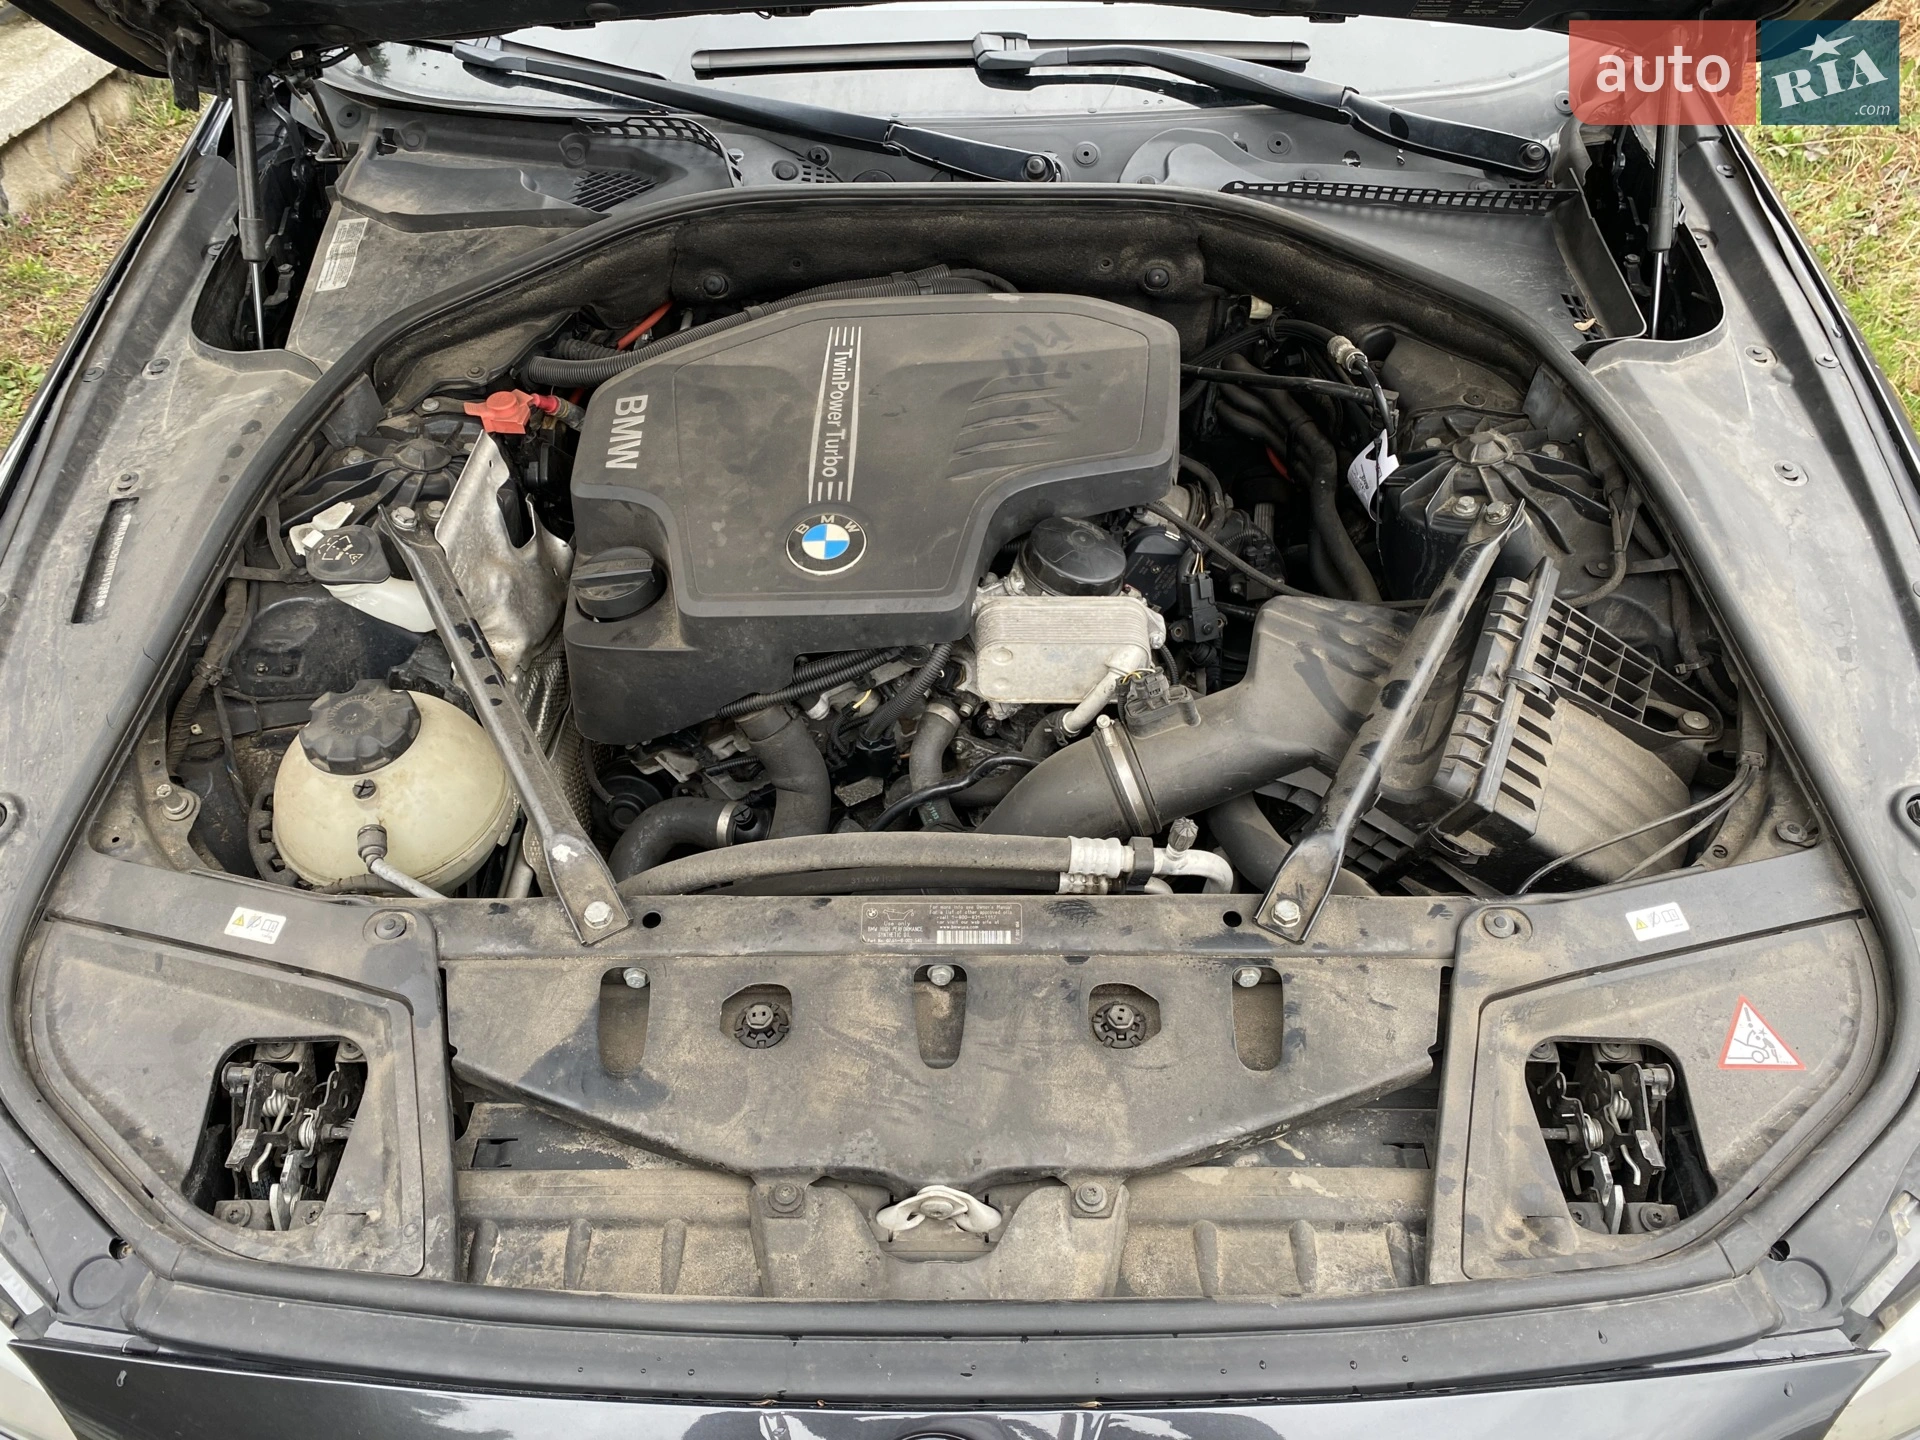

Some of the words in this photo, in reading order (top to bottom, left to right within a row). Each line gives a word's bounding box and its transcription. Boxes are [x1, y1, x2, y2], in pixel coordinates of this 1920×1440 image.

[827, 349, 853, 427] TwinPower
[605, 394, 649, 469] BMW
[822, 428, 846, 478] Turbo
[795, 514, 860, 535] BMW
[898, 920, 910, 928] only
